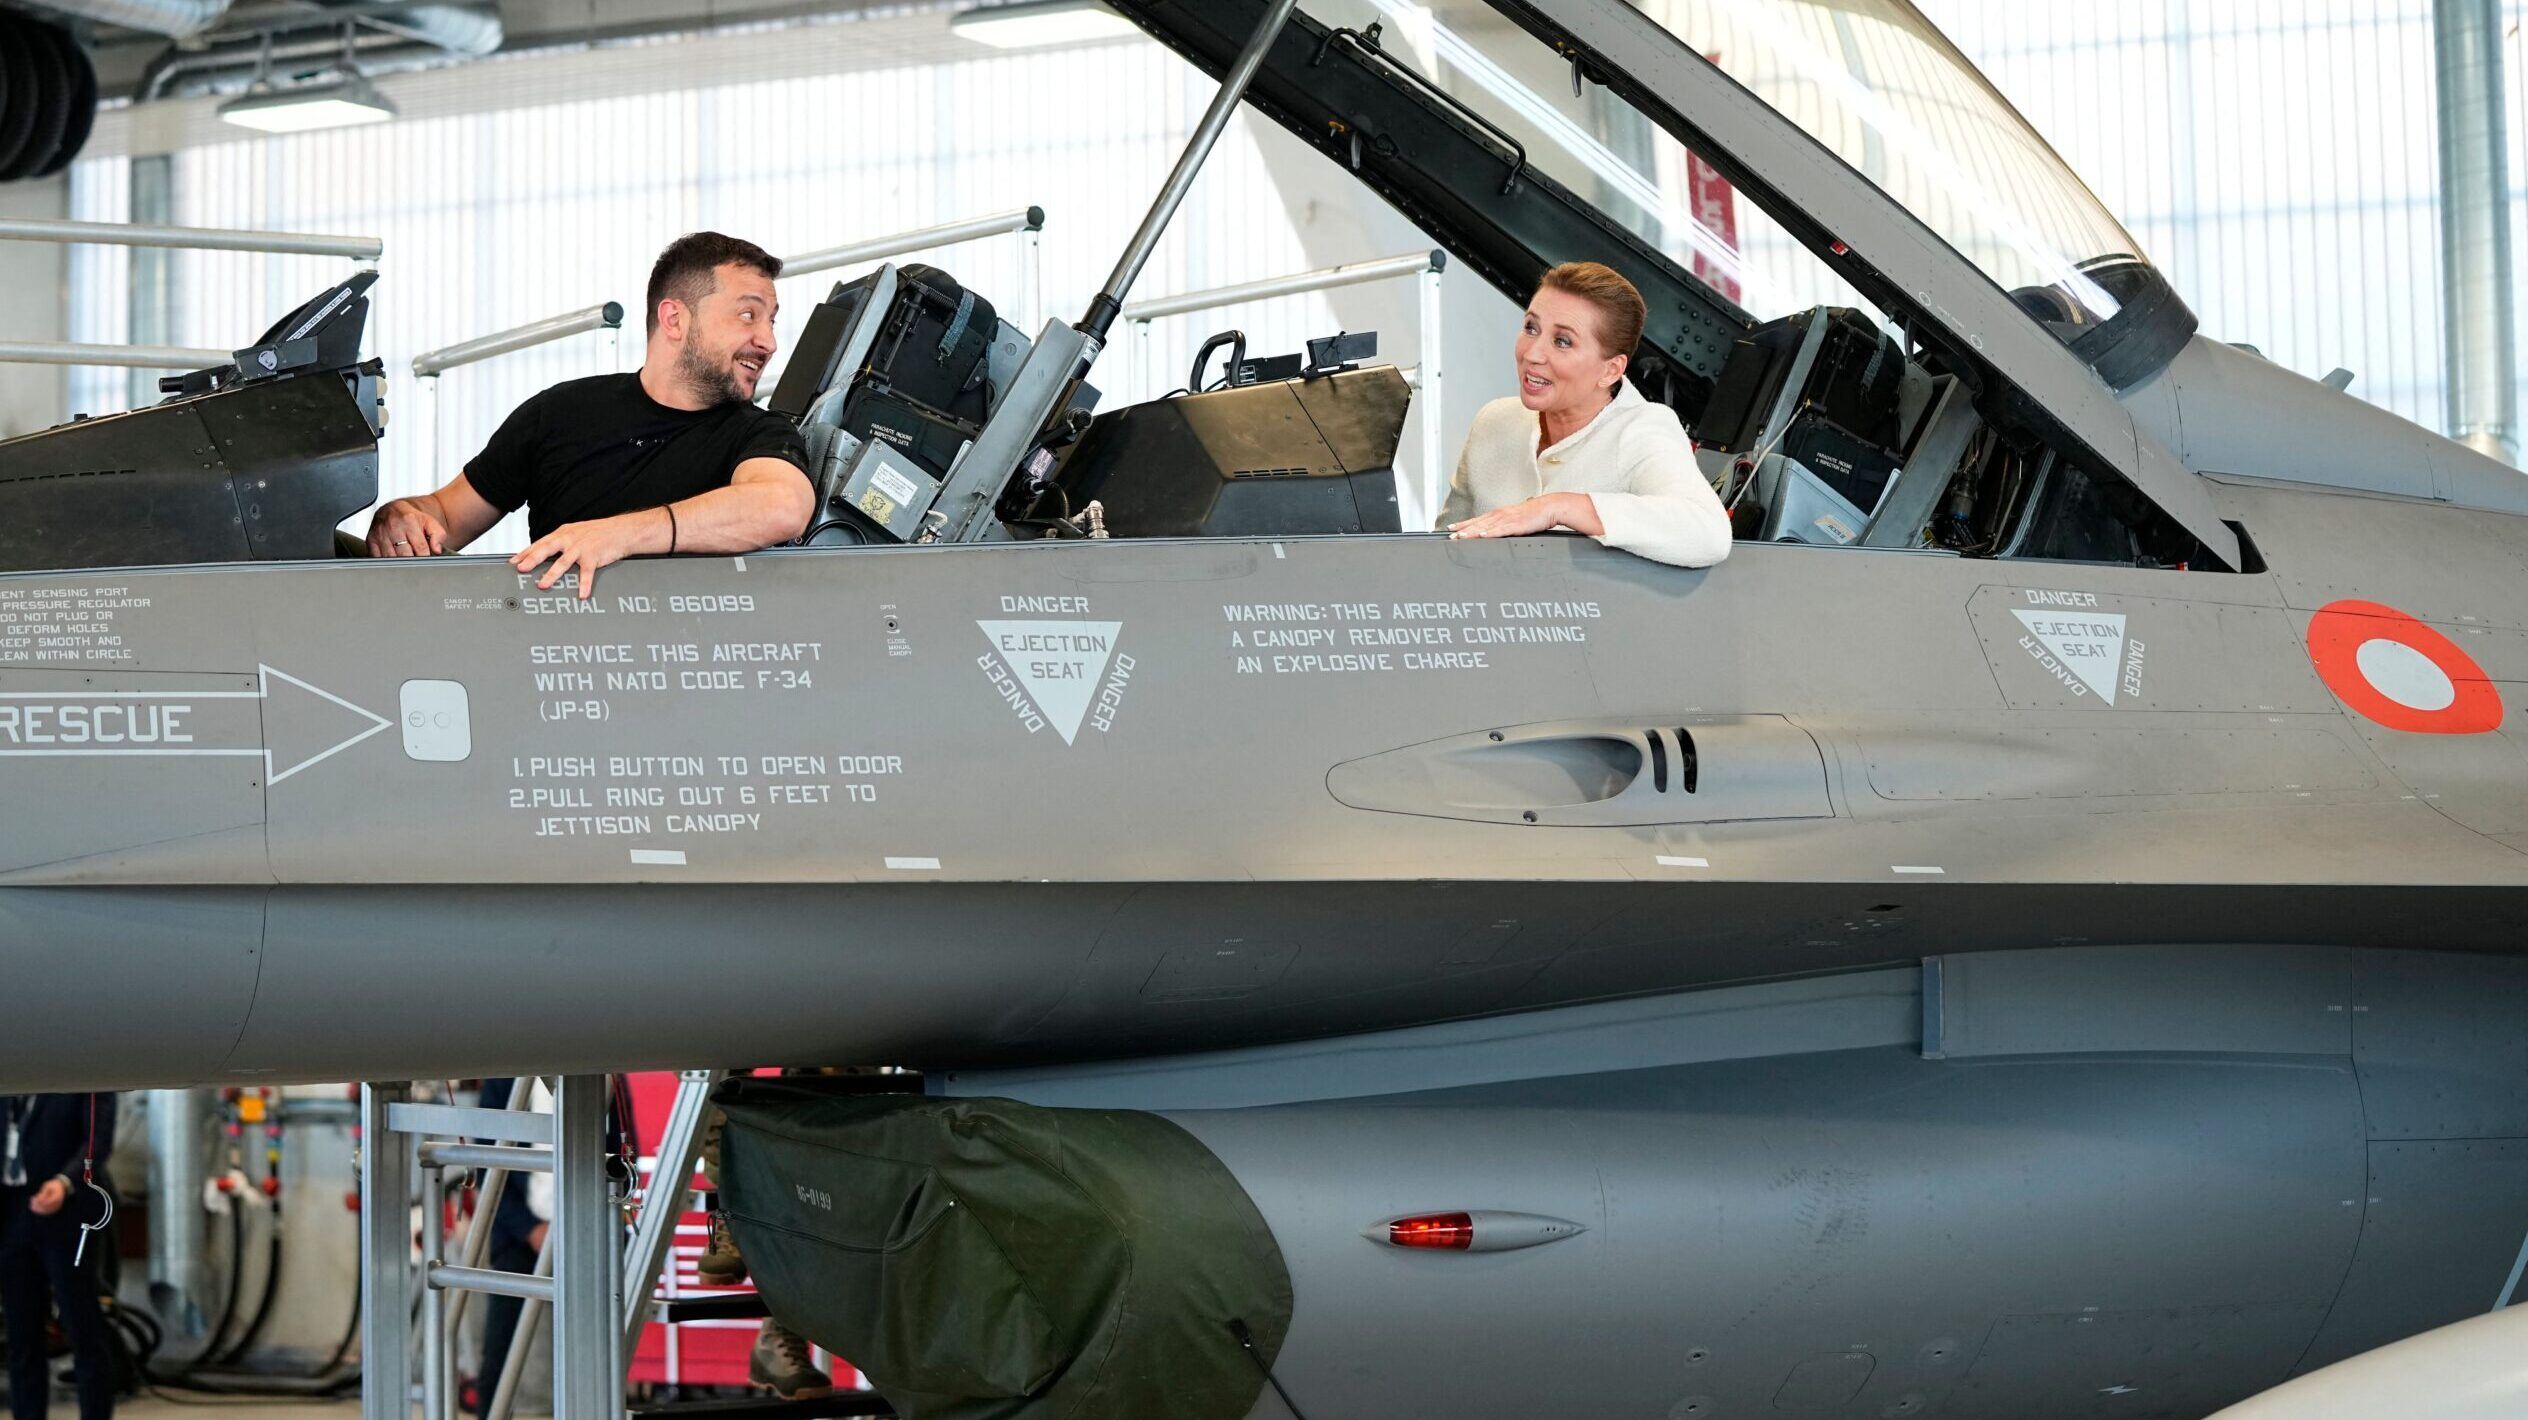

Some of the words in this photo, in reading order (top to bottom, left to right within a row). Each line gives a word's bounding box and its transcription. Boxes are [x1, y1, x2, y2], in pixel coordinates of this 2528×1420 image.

[0, 590, 24, 600] ENT
[33, 589, 88, 599] SENSING
[96, 587, 128, 597] PORT
[2026, 589, 2098, 607] DANGER
[3, 600, 71, 611] PRESSURE
[78, 598, 151, 608] REGULATOR
[523, 597, 605, 614] SERIAL
[669, 595, 755, 612] 860199
[1001, 596, 1089, 613] DANGER
[1223, 603, 1327, 621] WARNING:
[1331, 603, 1381, 620] THIS
[1393, 602, 1487, 620] AIRCRAFT
[1500, 602, 1601, 619] CONTAINS
[0, 613, 17, 622] DO
[24, 612, 48, 622] NOT
[56, 611, 89, 621] PLUG
[96, 611, 113, 620] OR
[8, 624, 60, 635] DEFORM
[68, 623, 109, 633] HOLES
[1232, 630, 1245, 647] A
[1253, 629, 1336, 647] CANOPY
[1349, 627, 1453, 645] REMOVER
[1463, 626, 1586, 644] CONTAINING
[2033, 622, 2119, 638] EJECTION
[39, 636, 91, 647] SMOOTH
[98, 636, 121, 646] AND
[1001, 634, 1107, 653] EJECTION
[2062, 643, 2107, 658] SEAT
[36, 650, 79, 661] WITHIN
[86, 649, 132, 660] CIRCLE
[530, 645, 634, 664] SERVICE
[647, 644, 700, 662] THIS
[713, 643, 822, 662] AIRCRAFT
[1236, 655, 1262, 673] AN
[1273, 654, 1394, 672] EXPLOSIVE
[1404, 652, 1490, 670] CHARGE
[1031, 661, 1085, 680] SEAT
[2019, 635, 2088, 697] DANGER
[2124, 638, 2145, 697] DANGER
[535, 673, 594, 691] WITH
[607, 672, 667, 690] NATO
[681, 671, 745, 690] CODE
[758, 671, 812, 689] F-34
[977, 651, 1045, 734] DANGER
[1091, 652, 1137, 733] DANGER
[540, 700, 610, 722] (JP-8)
[0, 706, 194, 743] RESCUE
[610, 757, 704, 776] BUTTON
[718, 756, 747, 775] TO
[762, 756, 826, 775] OPEN
[839, 756, 903, 775] DOOR
[607, 788, 665, 806] RING
[679, 787, 725, 806] OUT
[739, 787, 755, 804] 6
[770, 785, 830, 804] FEET
[846, 785, 877, 803] TO
[535, 815, 651, 836] JETTISON
[667, 814, 761, 833] CANOPY
